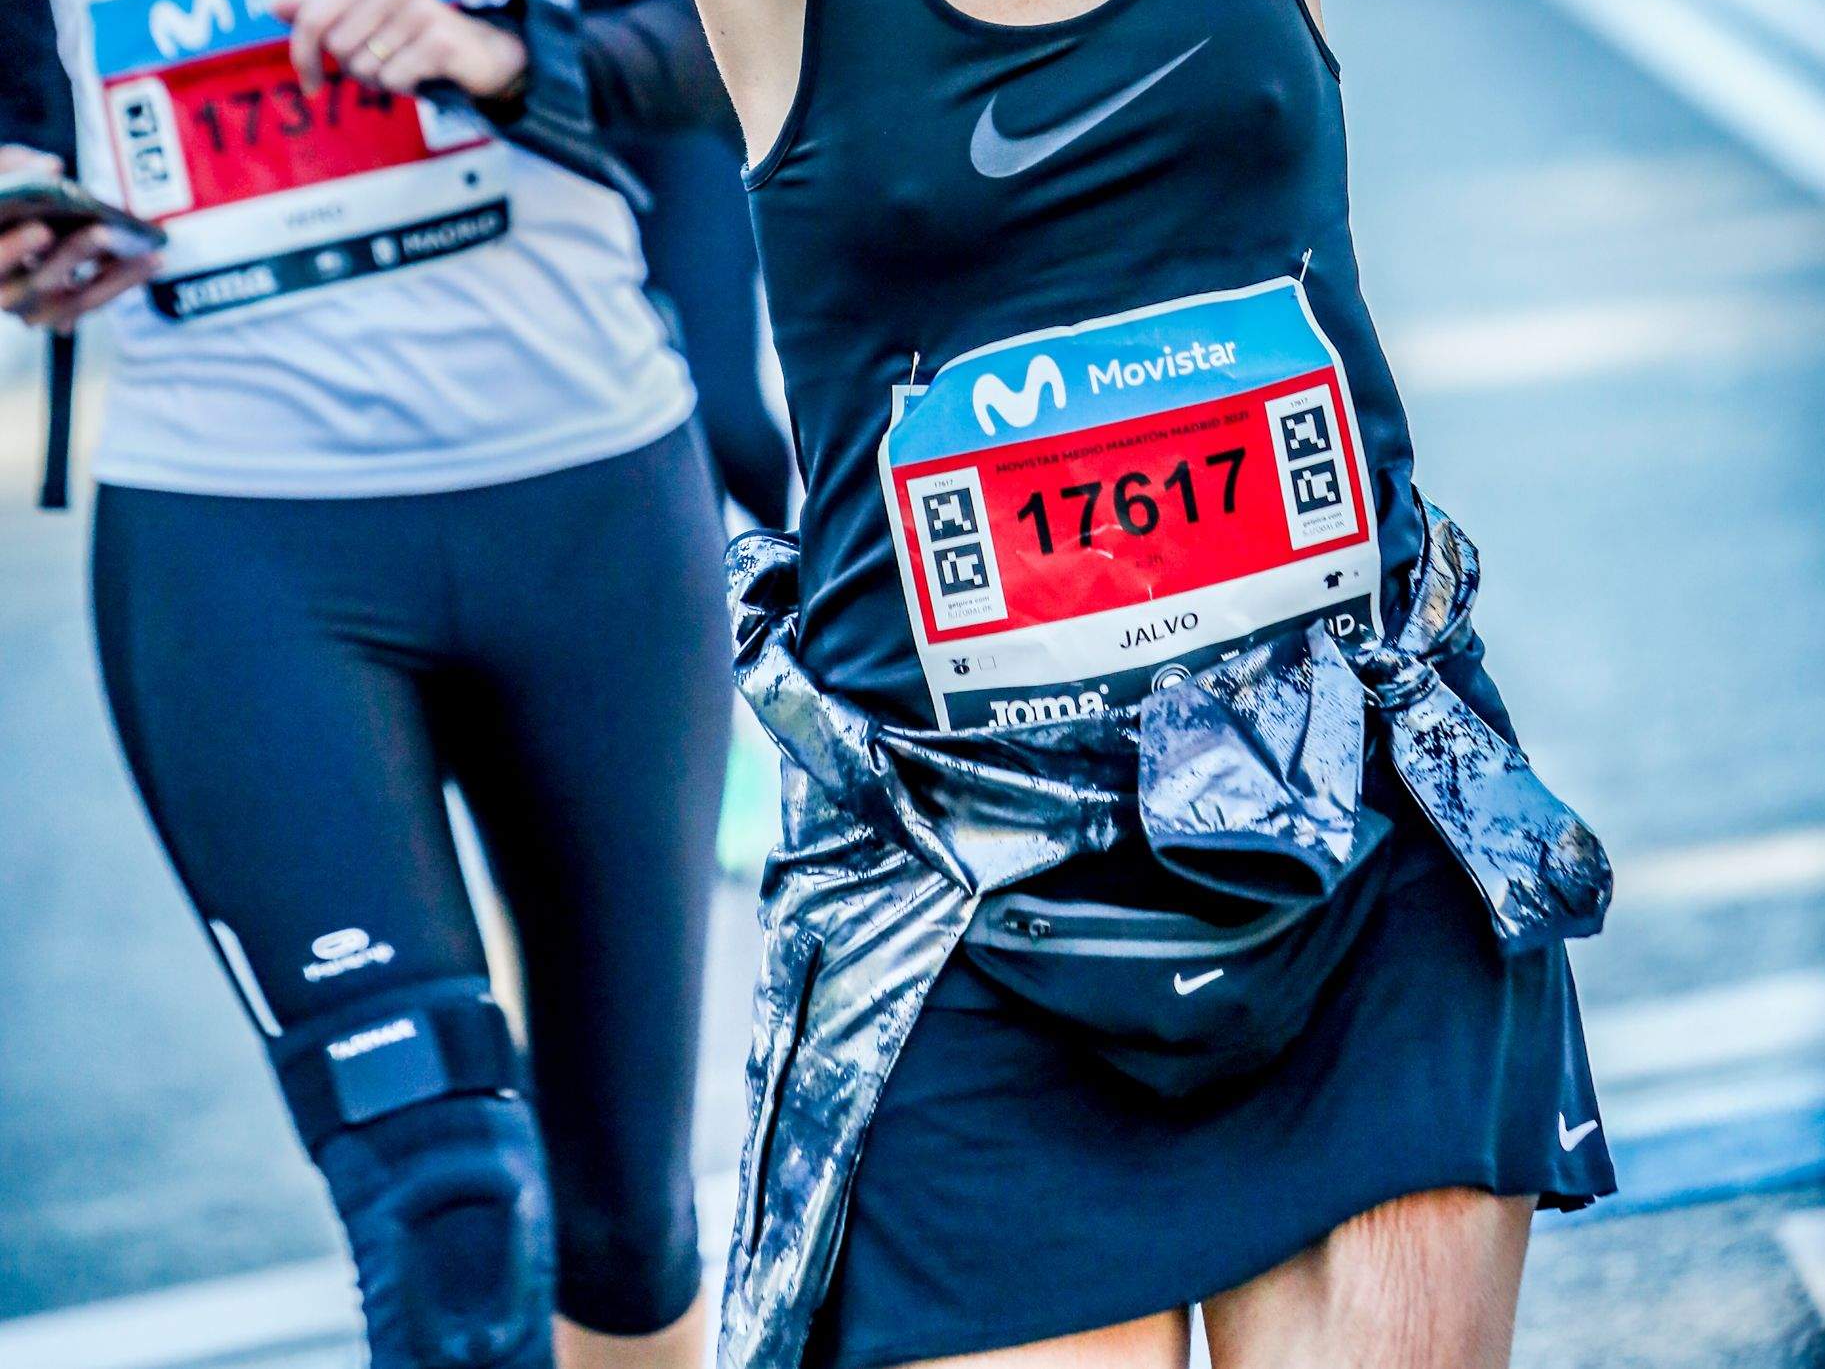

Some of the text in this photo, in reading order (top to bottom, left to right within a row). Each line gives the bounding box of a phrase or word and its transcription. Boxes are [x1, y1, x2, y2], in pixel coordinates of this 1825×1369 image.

[1087, 340, 1236, 395] Movistar
[996, 454, 1059, 475] MOVISTAR
[1062, 444, 1103, 463] MEDIO
[1171, 418, 1220, 438] MADRID
[1016, 447, 1248, 555] 17617
[1120, 612, 1199, 649] JALVO
